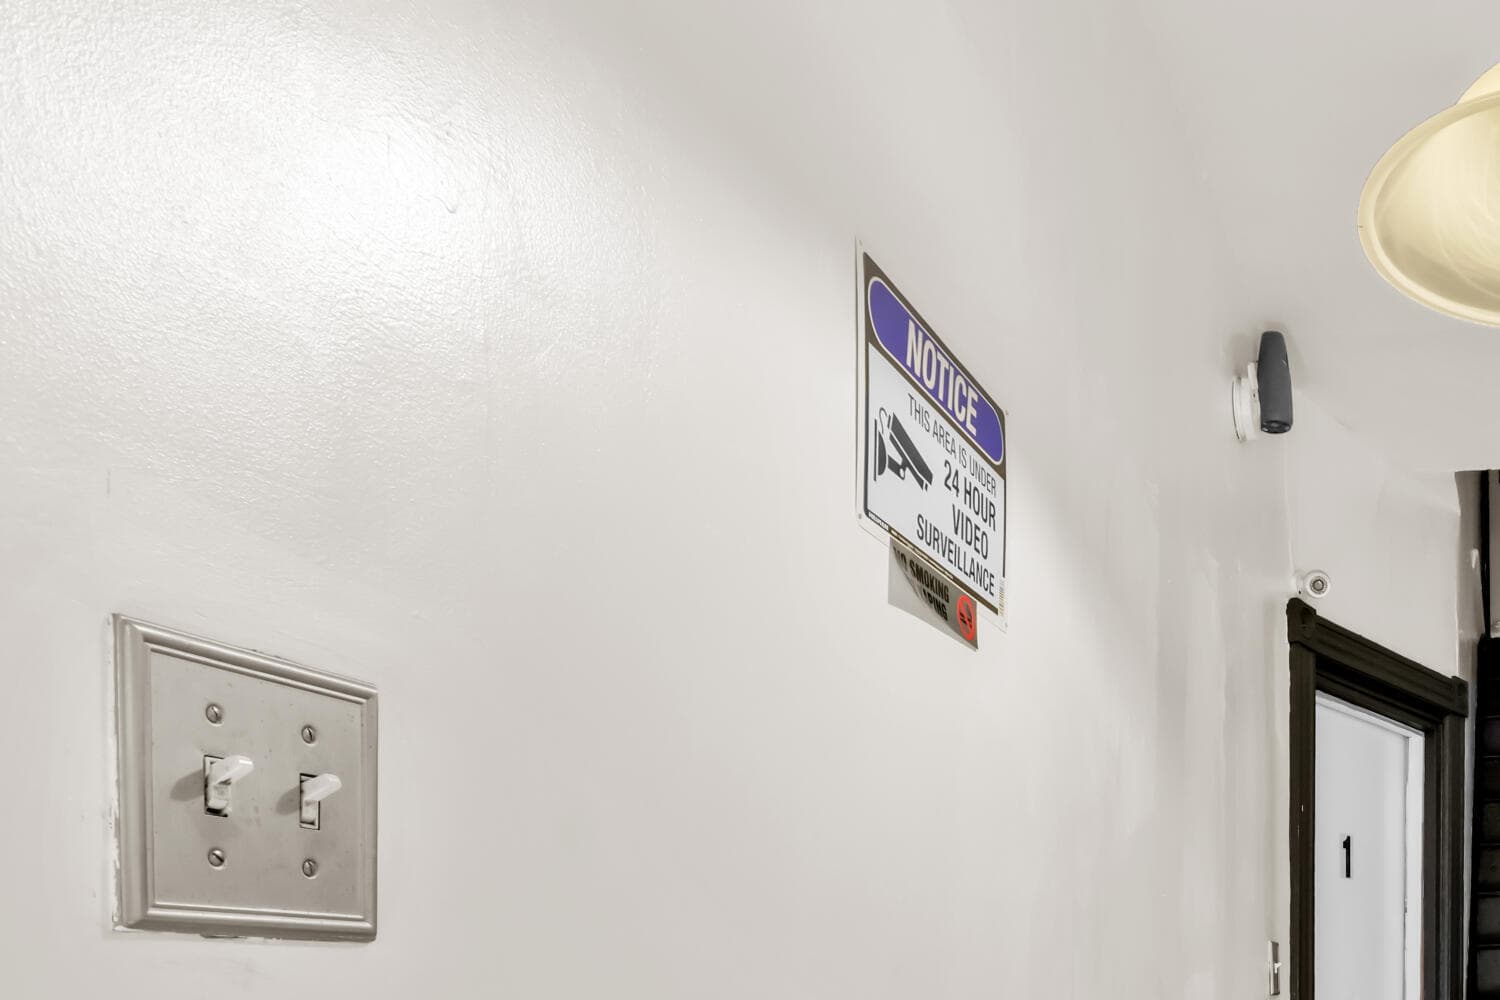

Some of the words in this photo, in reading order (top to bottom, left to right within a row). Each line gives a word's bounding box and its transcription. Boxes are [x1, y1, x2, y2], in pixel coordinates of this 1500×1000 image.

[906, 319, 978, 437] NOTICE
[907, 392, 931, 433] THIS
[932, 419, 956, 456] AREA
[955, 446, 968, 469] IS
[969, 455, 996, 498] UNDER
[943, 459, 960, 498] 24
[964, 480, 997, 532] HOUR
[952, 503, 989, 560] VIDEO
[909, 560, 950, 604] SMOKING
[916, 513, 995, 597] SURVEILLANCE
[1342, 835, 1351, 879] 1
